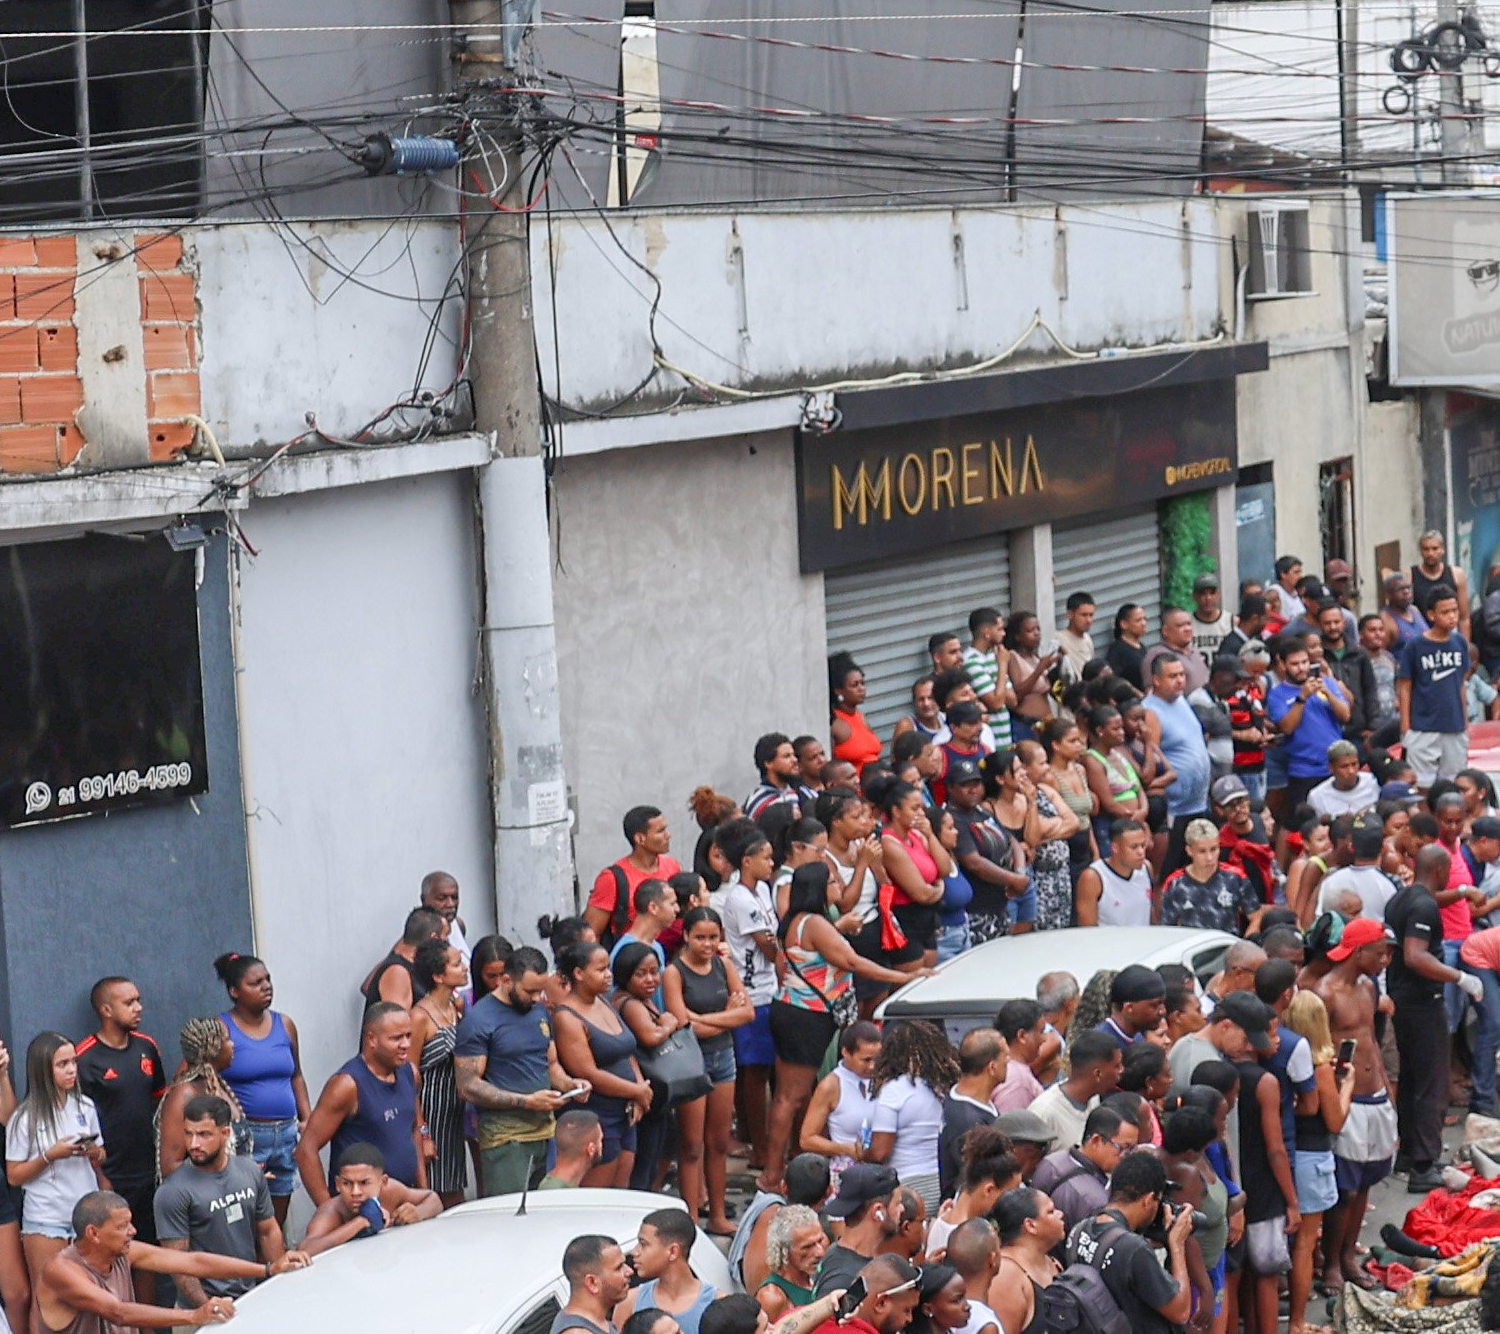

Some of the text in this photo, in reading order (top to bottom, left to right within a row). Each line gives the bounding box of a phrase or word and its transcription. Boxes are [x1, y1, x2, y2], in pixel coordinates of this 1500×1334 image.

[1421, 650, 1462, 670] NIKE
[58, 762, 191, 806] 21 99146-4599
[209, 1187, 255, 1213] ALPHA
